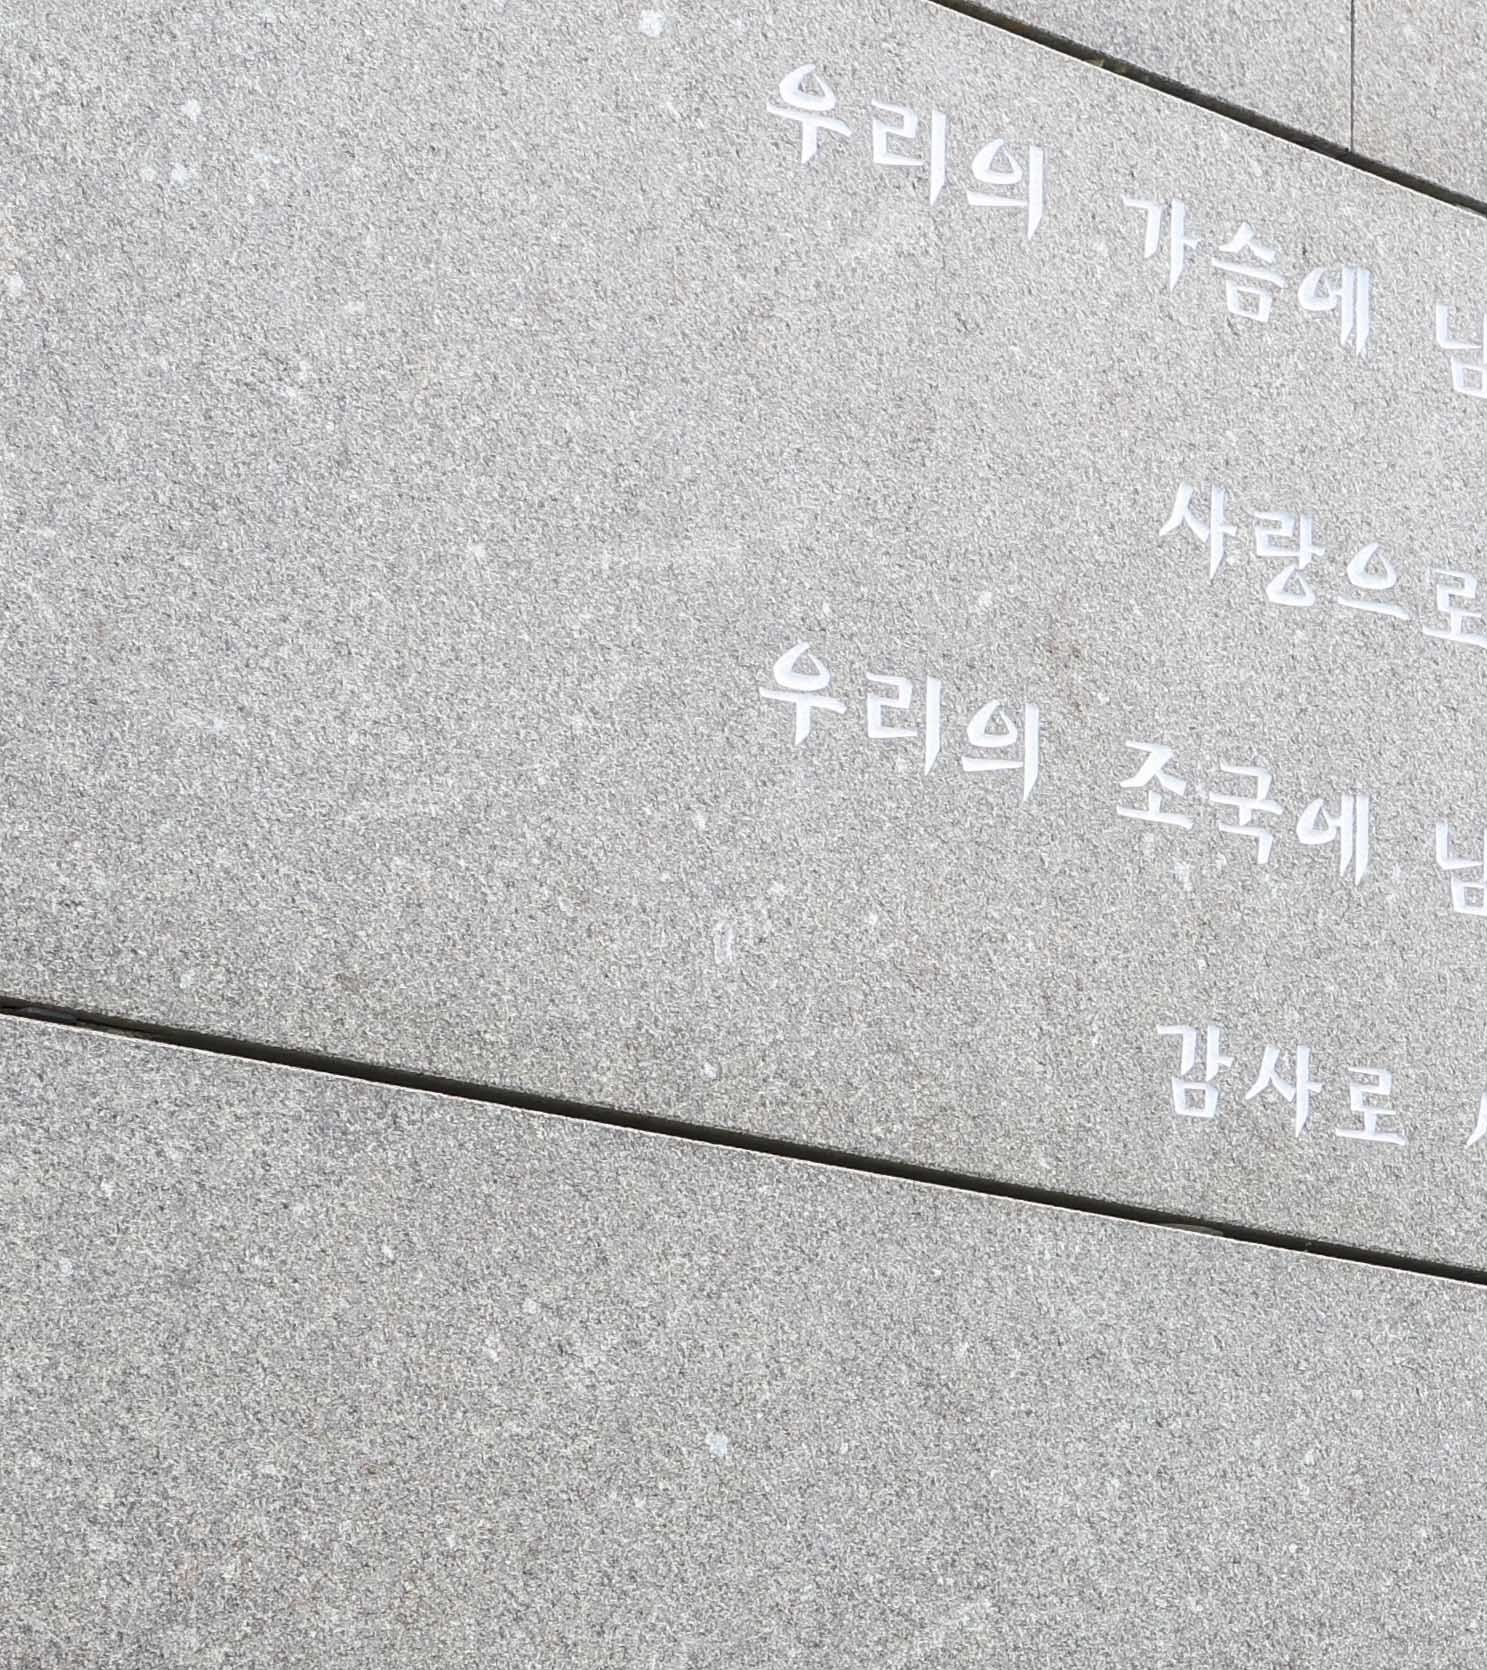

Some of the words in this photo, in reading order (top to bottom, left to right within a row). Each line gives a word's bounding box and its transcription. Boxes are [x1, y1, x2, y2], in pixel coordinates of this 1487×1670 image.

[766, 63, 1045, 240] 우리의
[1122, 198, 1372, 358] 가슴에
[758, 640, 1041, 799] 우리의
[1115, 740, 1372, 887] 조국에
[1156, 1022, 1407, 1147] 감사로
